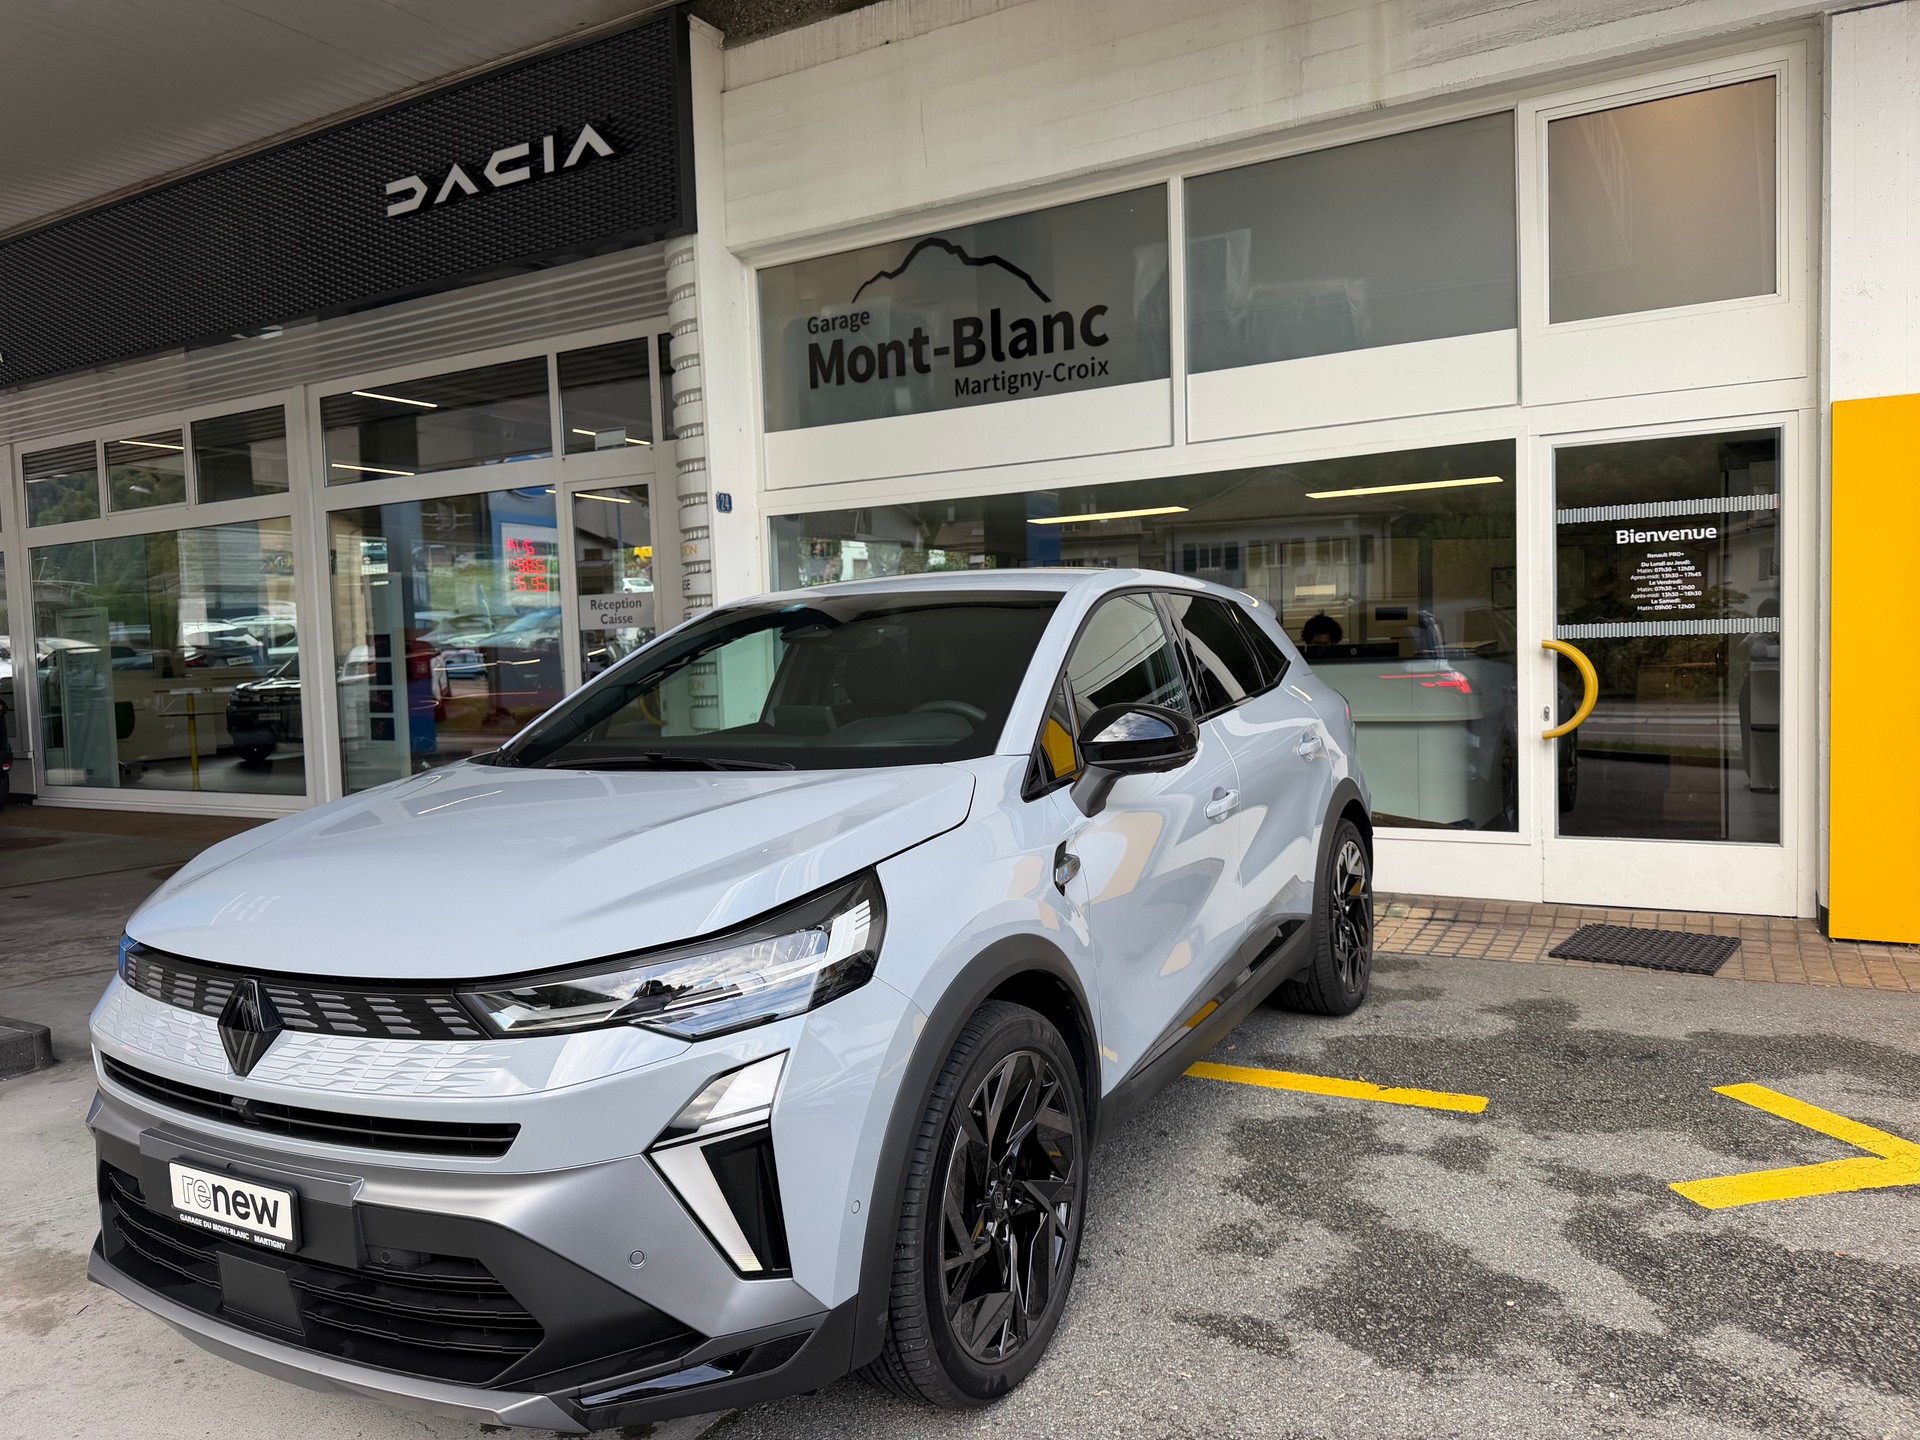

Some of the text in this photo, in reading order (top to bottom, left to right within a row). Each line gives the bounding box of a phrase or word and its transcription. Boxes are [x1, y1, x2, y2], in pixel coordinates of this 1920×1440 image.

[386, 123, 616, 217] DACIA
[807, 308, 870, 334] Garage
[808, 304, 1109, 390] Mont-Blanc
[954, 356, 1109, 398] Martigny-Croix
[721, 495, 729, 510] 24
[1616, 527, 1717, 545] Bienvenue
[590, 598, 642, 612] Réception
[600, 614, 633, 625] Caisse
[182, 1175, 278, 1228] renew
[180, 1214, 286, 1250] GARAGE DU MONT-BLANC MARTIGNY
